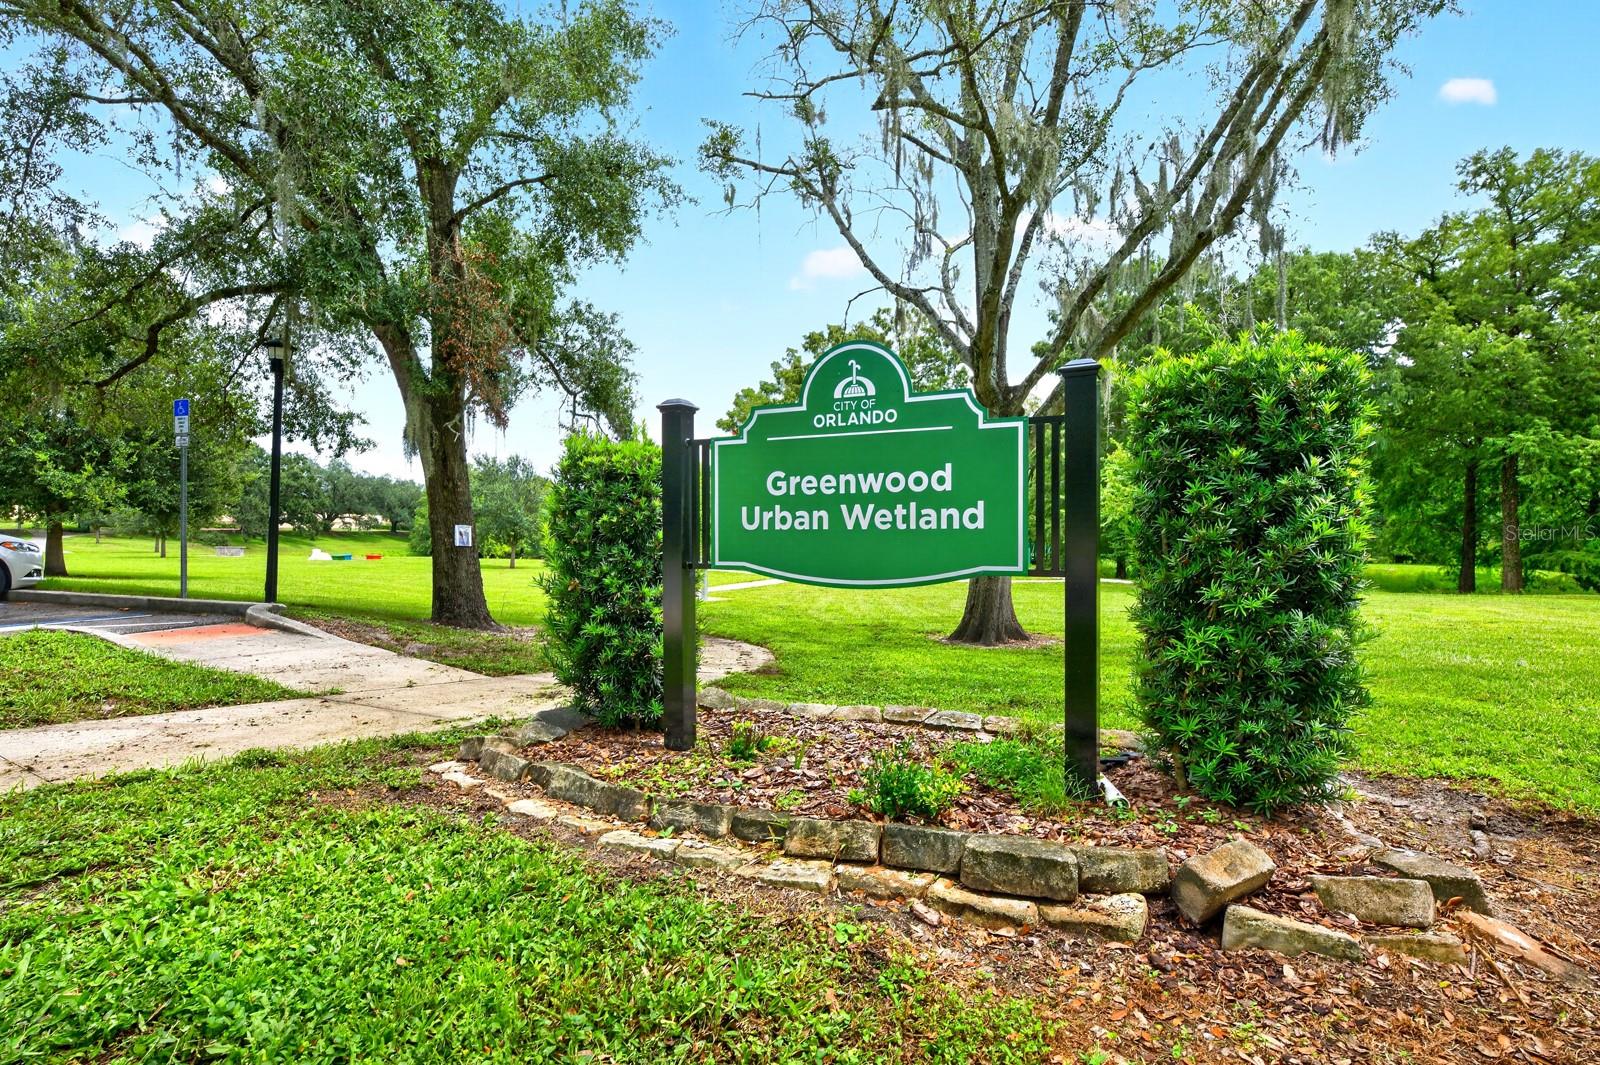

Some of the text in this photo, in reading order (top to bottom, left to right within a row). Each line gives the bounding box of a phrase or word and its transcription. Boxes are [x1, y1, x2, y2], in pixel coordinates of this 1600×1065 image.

[813, 408, 898, 428] ORLANDO
[833, 399, 876, 412] CITY OF
[766, 462, 952, 496] Greenwood
[741, 500, 985, 531] Urban Wetland
